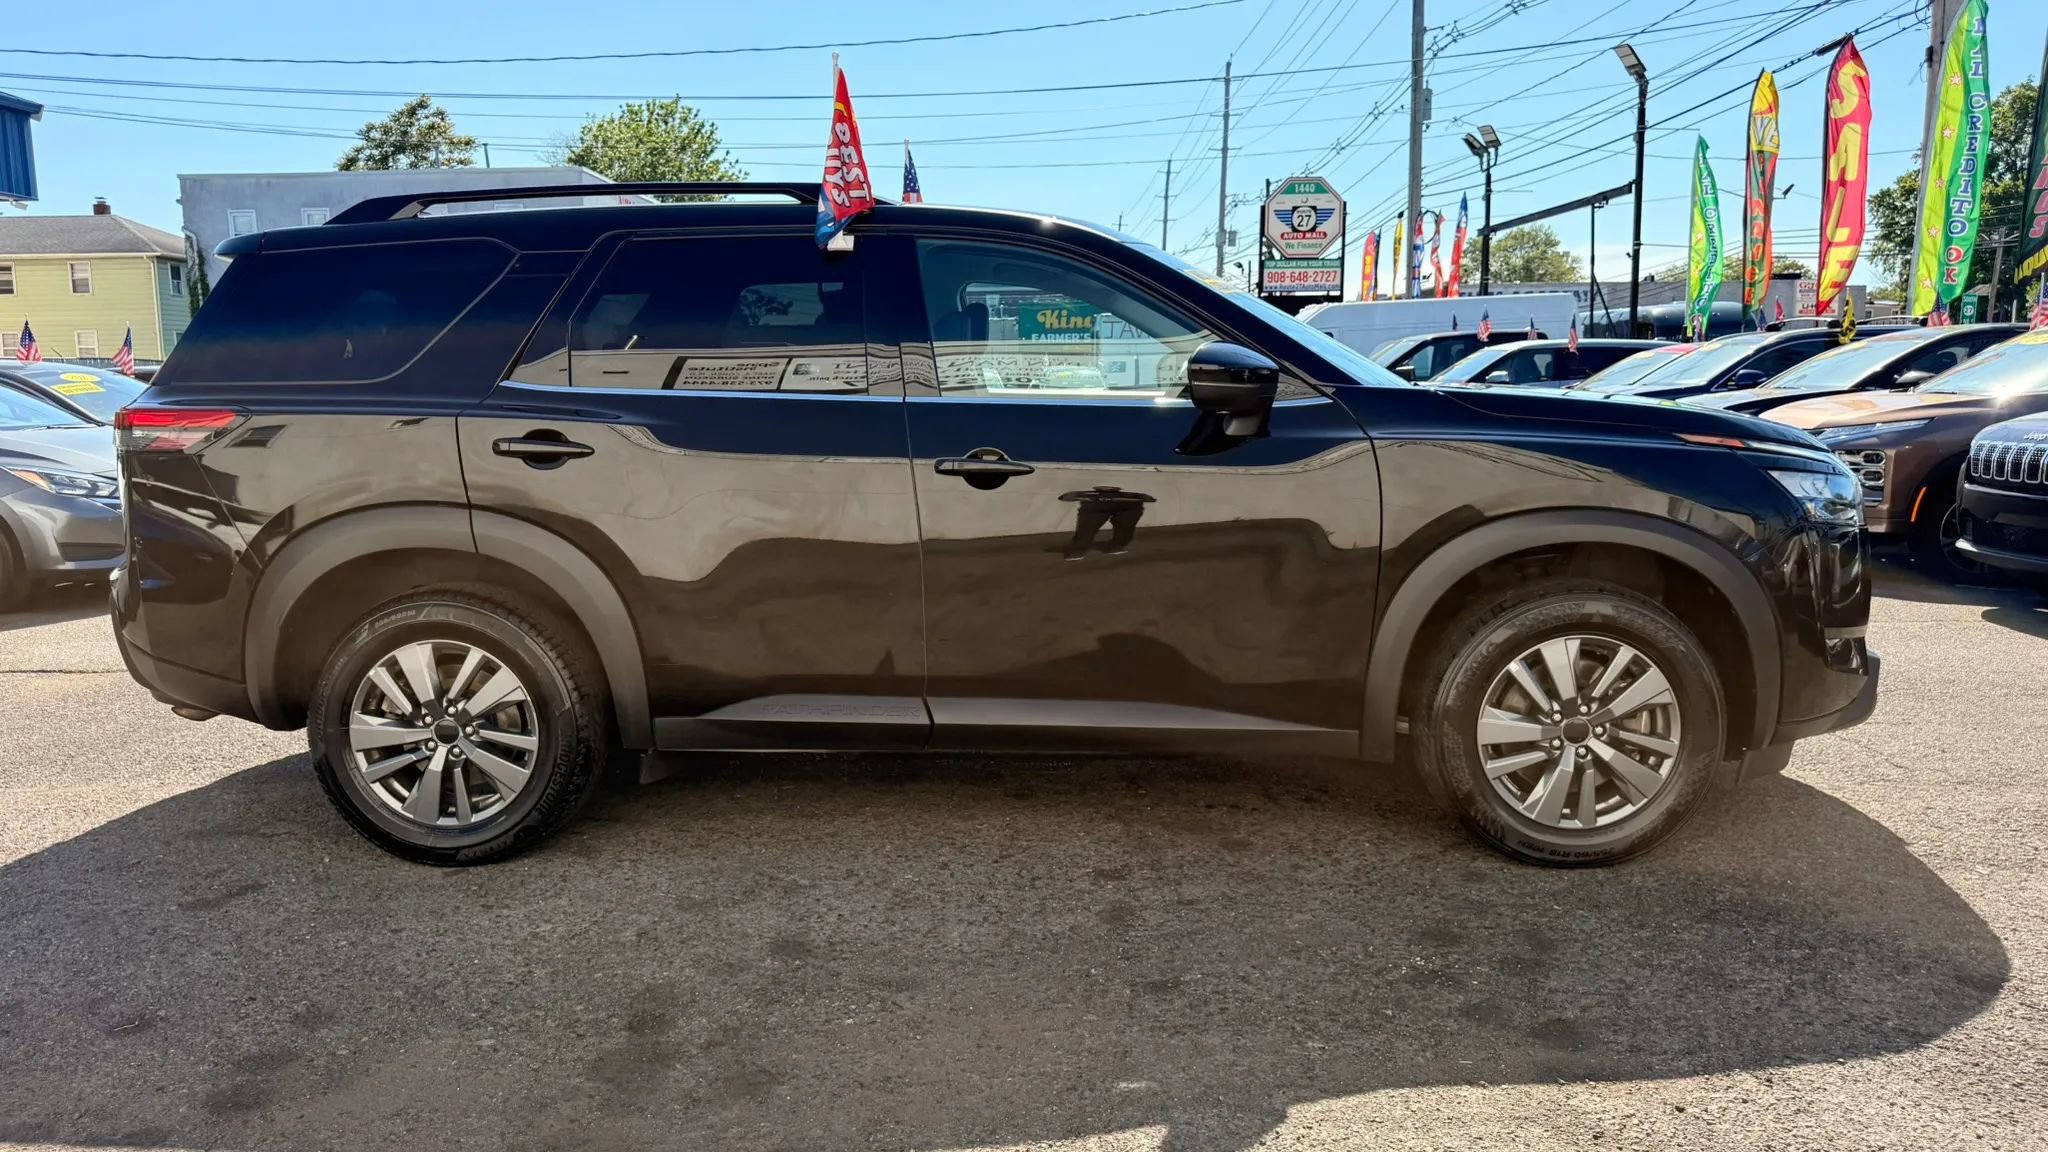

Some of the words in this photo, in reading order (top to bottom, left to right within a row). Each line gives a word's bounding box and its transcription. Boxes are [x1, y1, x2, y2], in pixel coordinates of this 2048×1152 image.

[824, 133, 851, 208] UYS
[1947, 91, 1988, 237] CREDITO
[1819, 60, 1867, 300] SALE
[1294, 183, 1316, 193] 1440
[1297, 214, 1312, 228] 27
[1944, 245, 1964, 285] OK
[1267, 271, 1338, 283] 908-648-2727
[1032, 333, 1091, 343] FARMER'S
[763, 704, 921, 717] PATHFINDER
